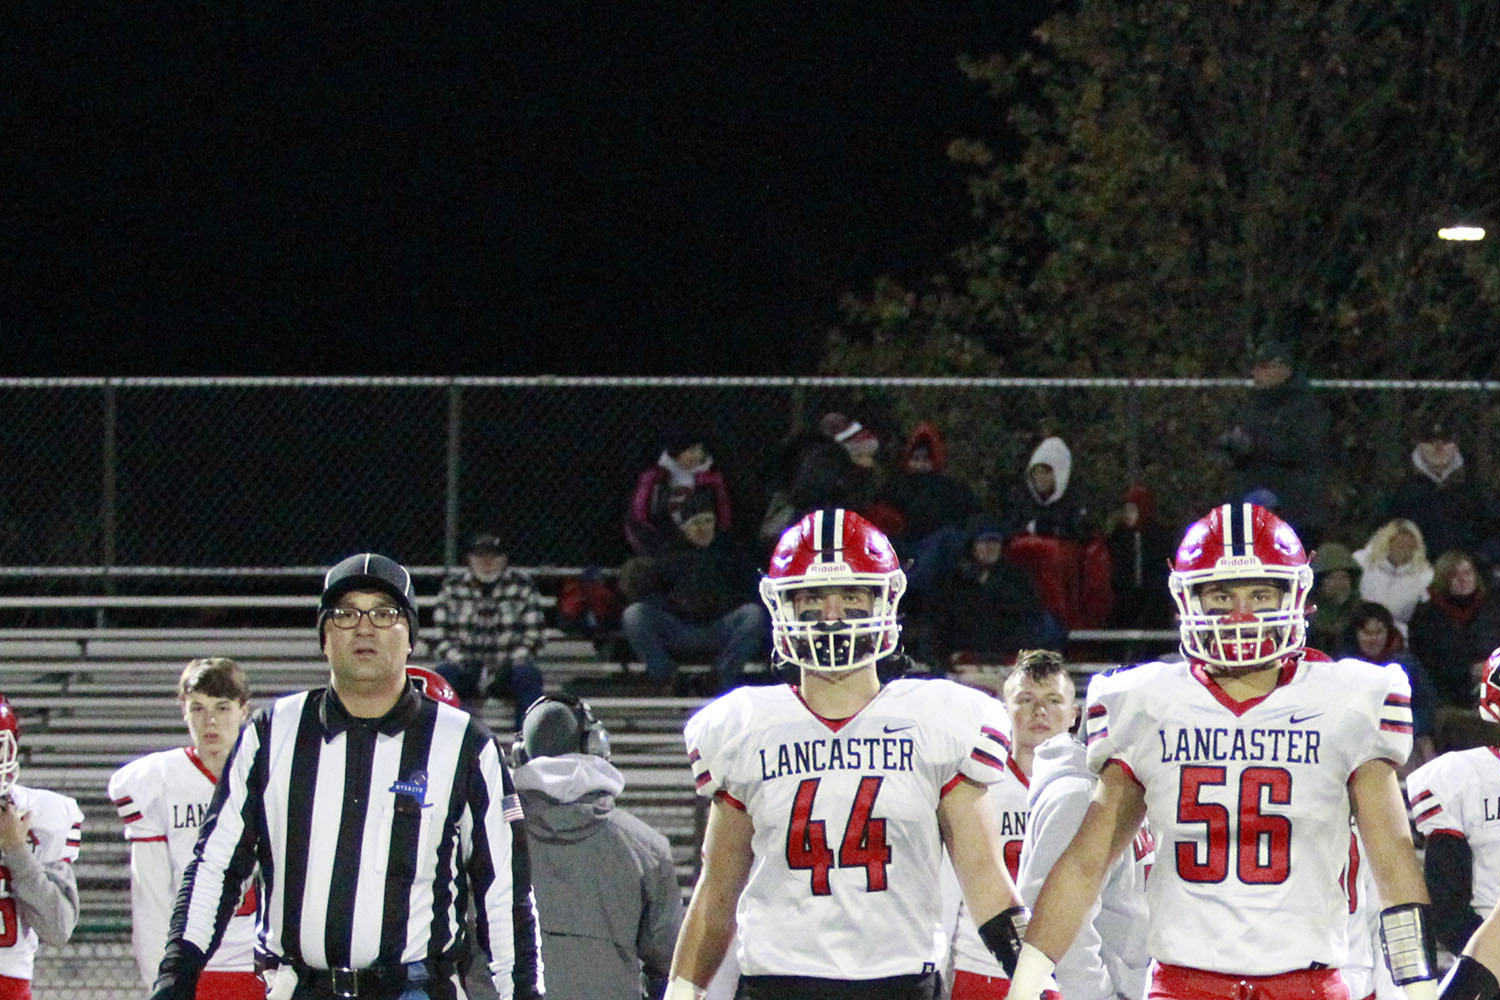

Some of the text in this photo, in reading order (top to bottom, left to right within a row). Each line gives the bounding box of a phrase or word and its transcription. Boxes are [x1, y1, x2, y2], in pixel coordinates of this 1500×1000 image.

[1220, 558, 1256, 567] Riddell
[760, 738, 915, 781] LANCASTER
[1159, 729, 1322, 764] LANCASTER
[786, 776, 893, 897] 44
[1174, 765, 1293, 886] 56
